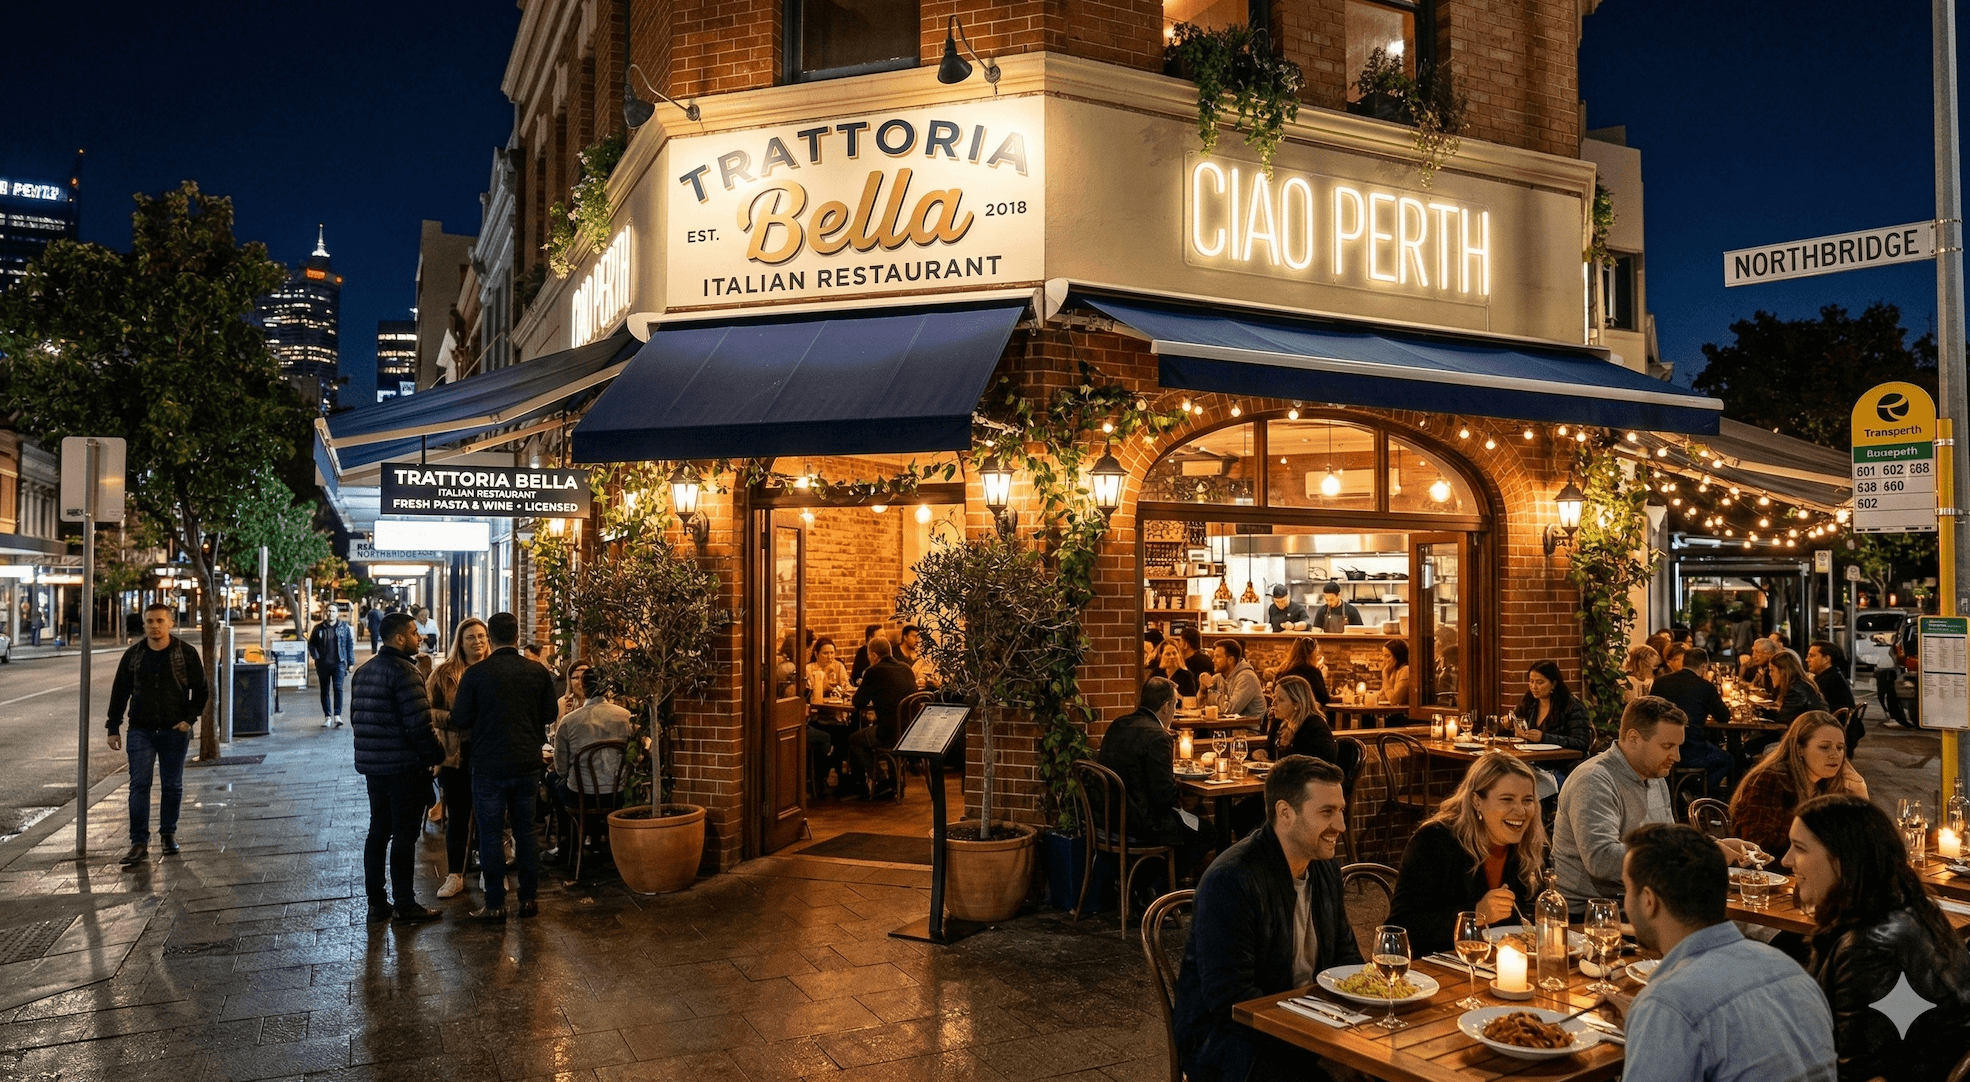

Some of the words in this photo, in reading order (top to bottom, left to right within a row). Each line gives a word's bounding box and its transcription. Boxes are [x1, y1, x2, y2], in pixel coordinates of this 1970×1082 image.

[679, 119, 1029, 204] TRATTORIA
[736, 168, 975, 267] Bella
[985, 201, 1028, 217] 2018
[686, 229, 720, 243] EST.
[1192, 161, 1314, 271] CIAO
[1331, 186, 1490, 297] PERTH
[1735, 229, 1920, 279] NORTHBRIDGE
[703, 271, 806, 297] ITALIAN
[817, 255, 1003, 288] RESTAURANT
[1864, 425, 1922, 438] Transperth
[393, 469, 511, 488] TRATTORIA
[515, 473, 579, 490] BELLA
[1857, 466, 1875, 477] 601
[1883, 464, 1904, 475] 602
[438, 489, 475, 498] ITALIAN
[476, 490, 537, 499] RESTAURANT
[393, 499, 430, 509] FRESH
[433, 500, 470, 510] PASTA
[472, 501, 480, 510] &
[483, 501, 514, 511] WINE
[524, 502, 579, 512] LICENSED
